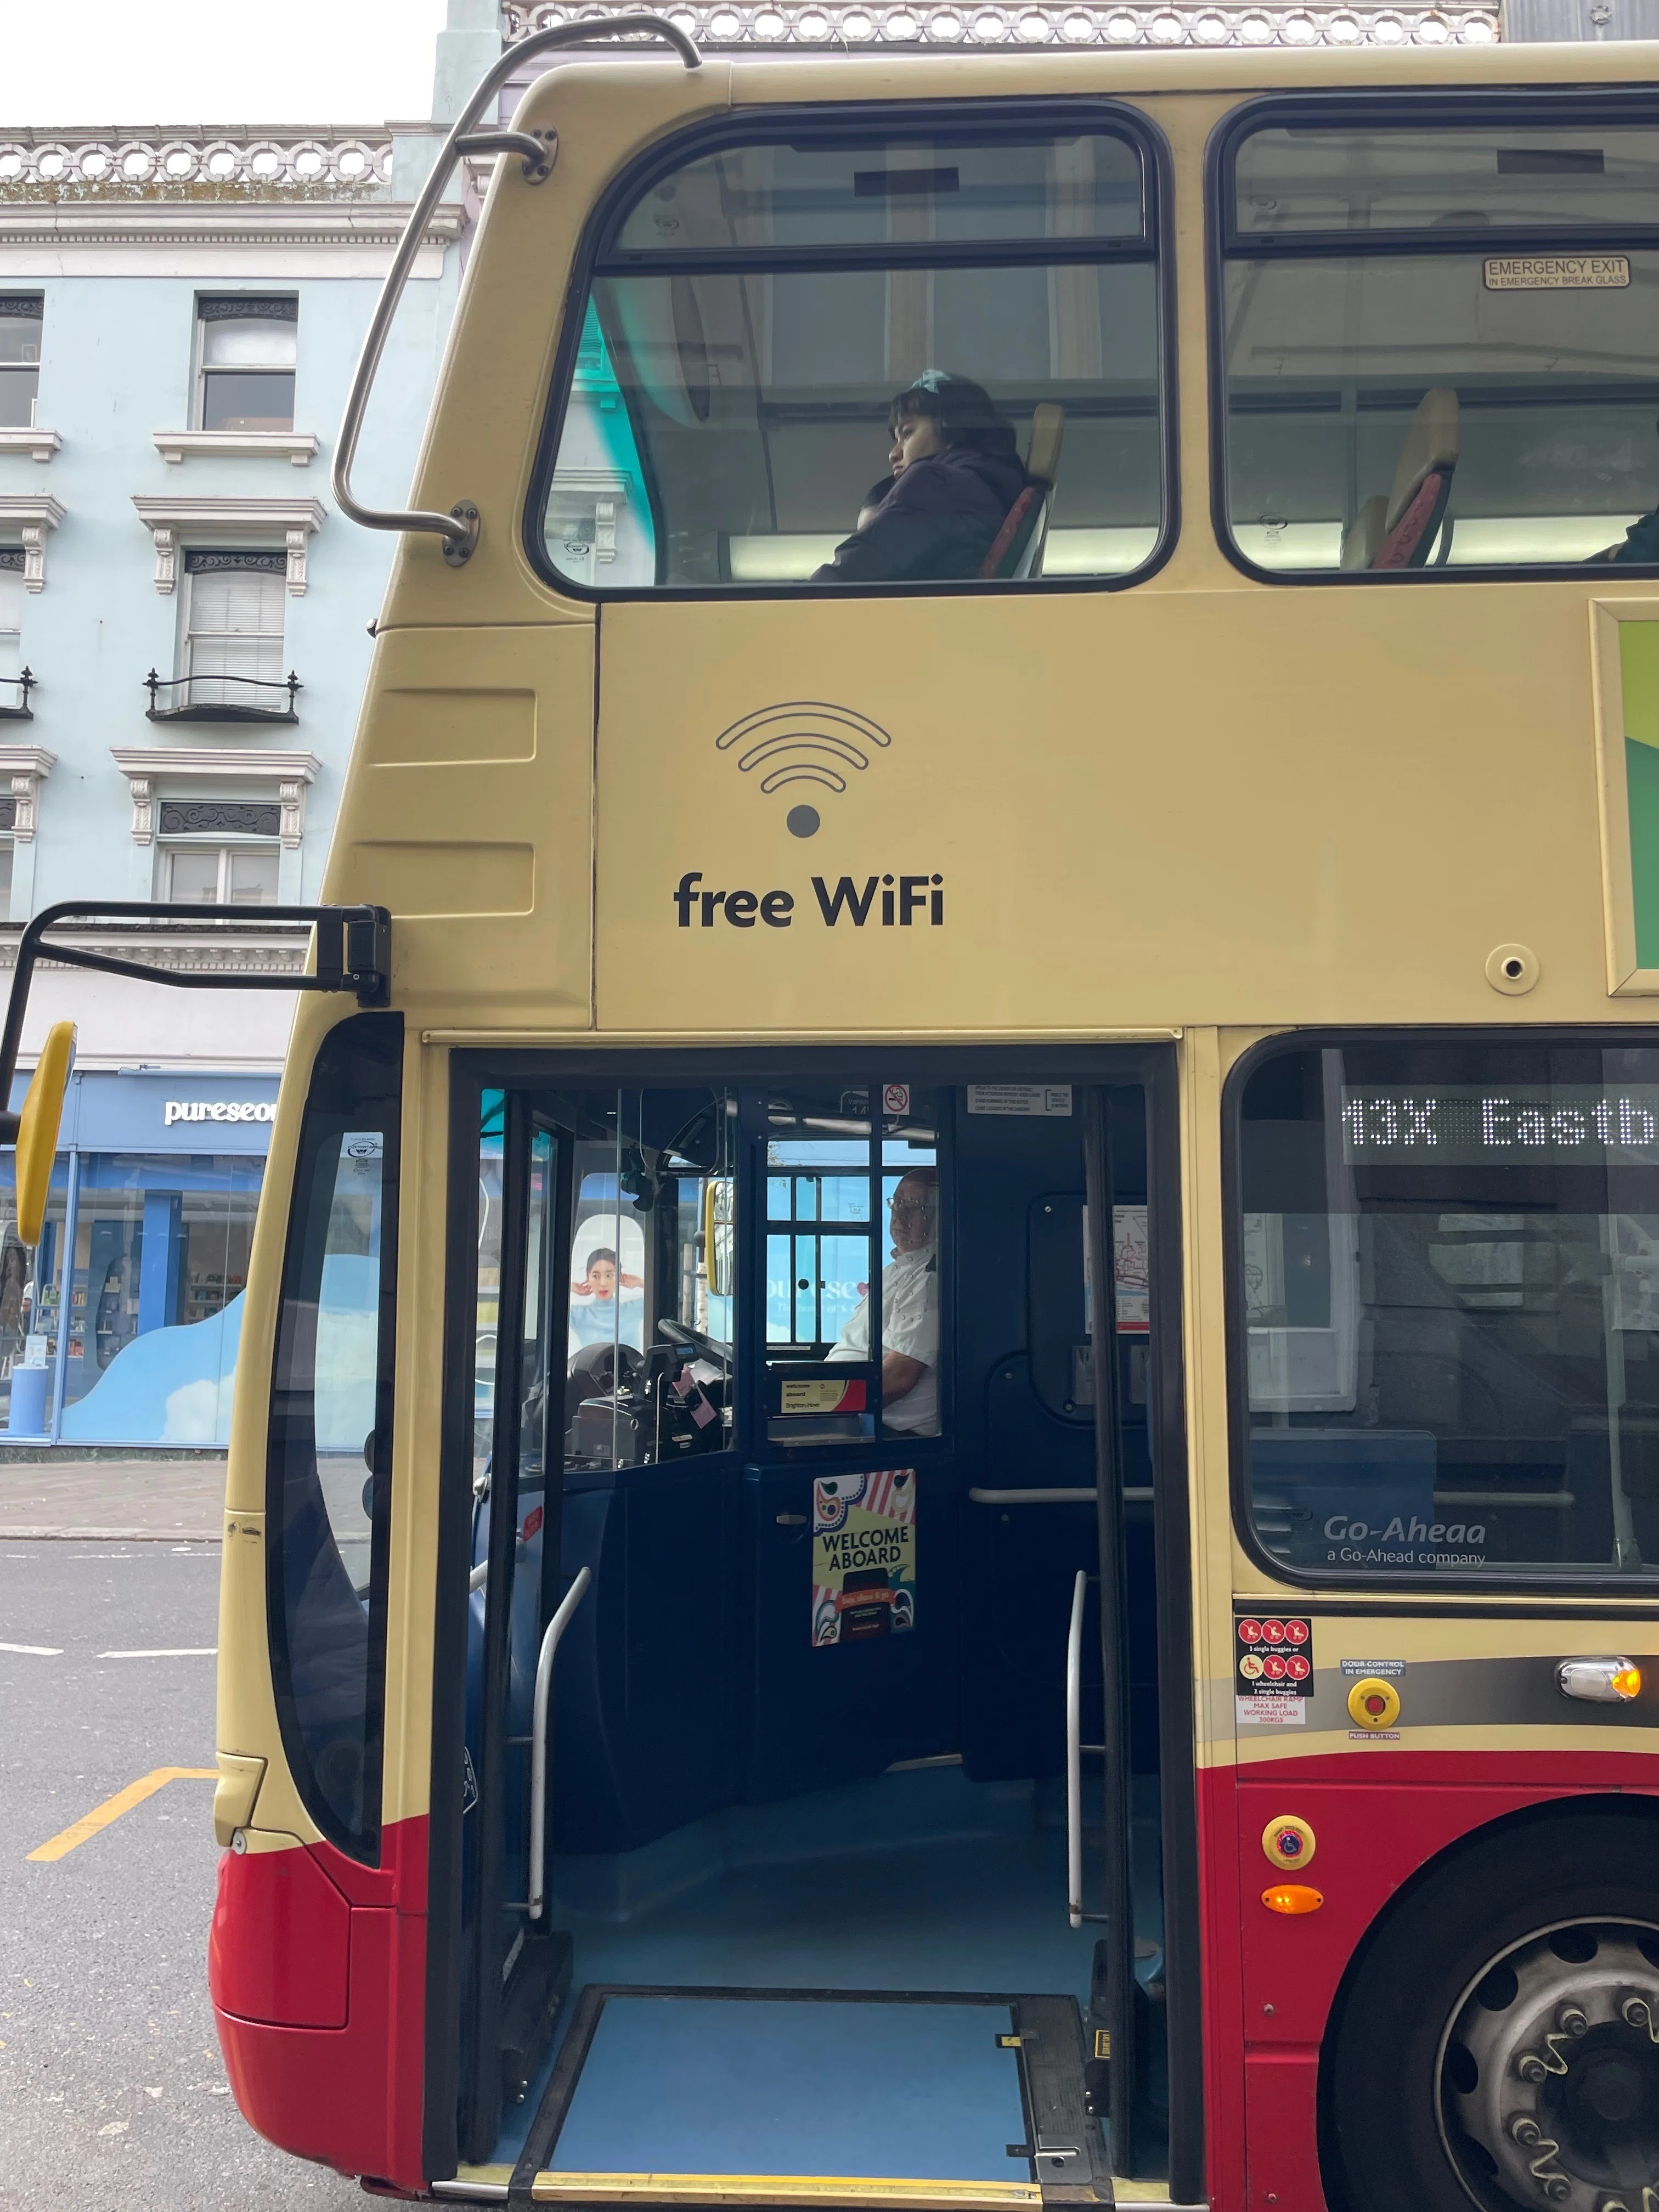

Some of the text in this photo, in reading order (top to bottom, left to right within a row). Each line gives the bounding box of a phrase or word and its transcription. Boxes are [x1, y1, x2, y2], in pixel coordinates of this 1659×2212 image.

[1489, 259, 1624, 275] EMERGENCY EXIT
[1500, 276, 1559, 286] EMERGENCY
[1562, 276, 1593, 285] BREAK
[1595, 275, 1626, 284] GLASS
[674, 872, 943, 928] free WiFi
[1342, 1099, 1654, 1145] 13X Eastb
[822, 1526, 909, 1553] WELCOME
[829, 1546, 901, 1571] ABOARD
[1327, 1548, 1486, 1568] a Go-Ahead company
